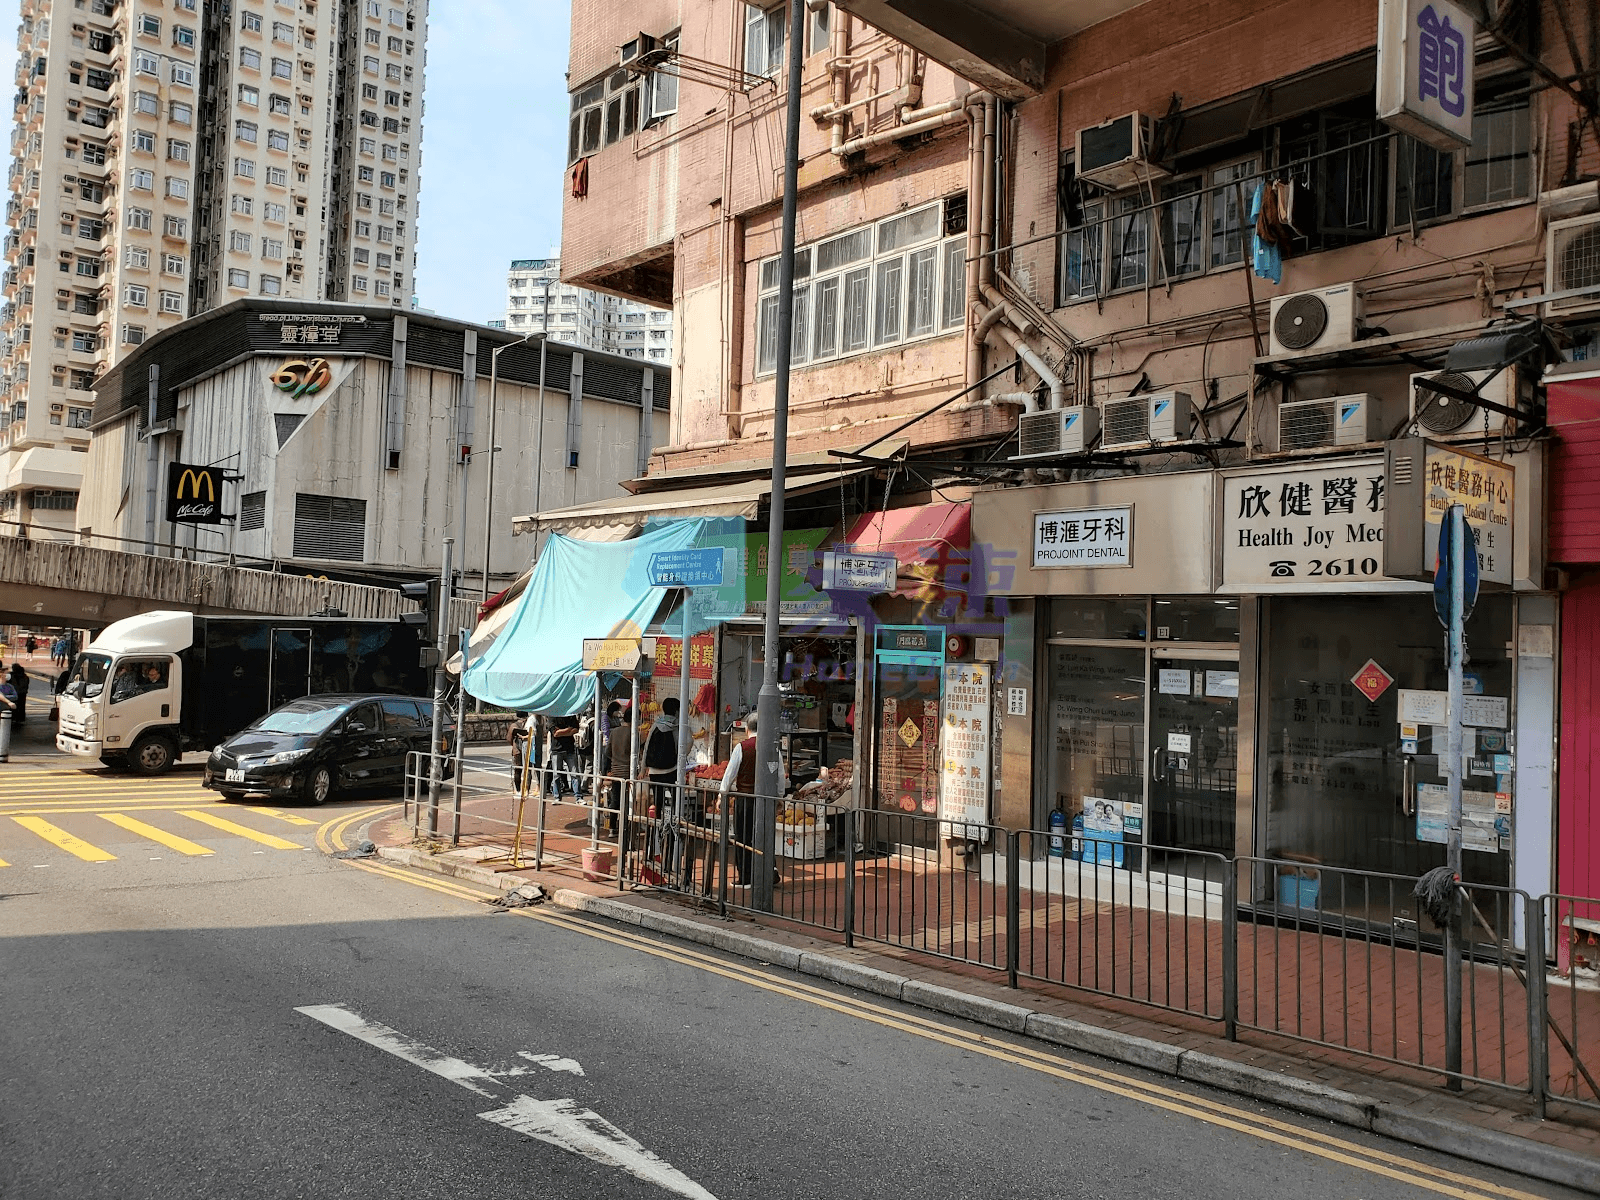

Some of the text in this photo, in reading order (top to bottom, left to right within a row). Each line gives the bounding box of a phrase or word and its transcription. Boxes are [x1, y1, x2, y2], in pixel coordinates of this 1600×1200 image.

[1417, 5, 1465, 118] 飽
[280, 325, 341, 345] 靈糧堂
[1430, 461, 1508, 505] 欣健醫務中心
[1464, 503, 1487, 521] Medical
[1488, 509, 1508, 526] Centre
[1238, 527, 1294, 547] Health
[1303, 525, 1335, 549] Joy
[657, 552, 702, 562] Smart Identity Card
[1037, 547, 1126, 560] PROJOINT DENTAL
[656, 561, 702, 571] Replacement Centre
[1307, 557, 1378, 577] 2610
[958, 671, 983, 686] 本院
[958, 717, 982, 732] 本院
[957, 764, 982, 779] 本院
